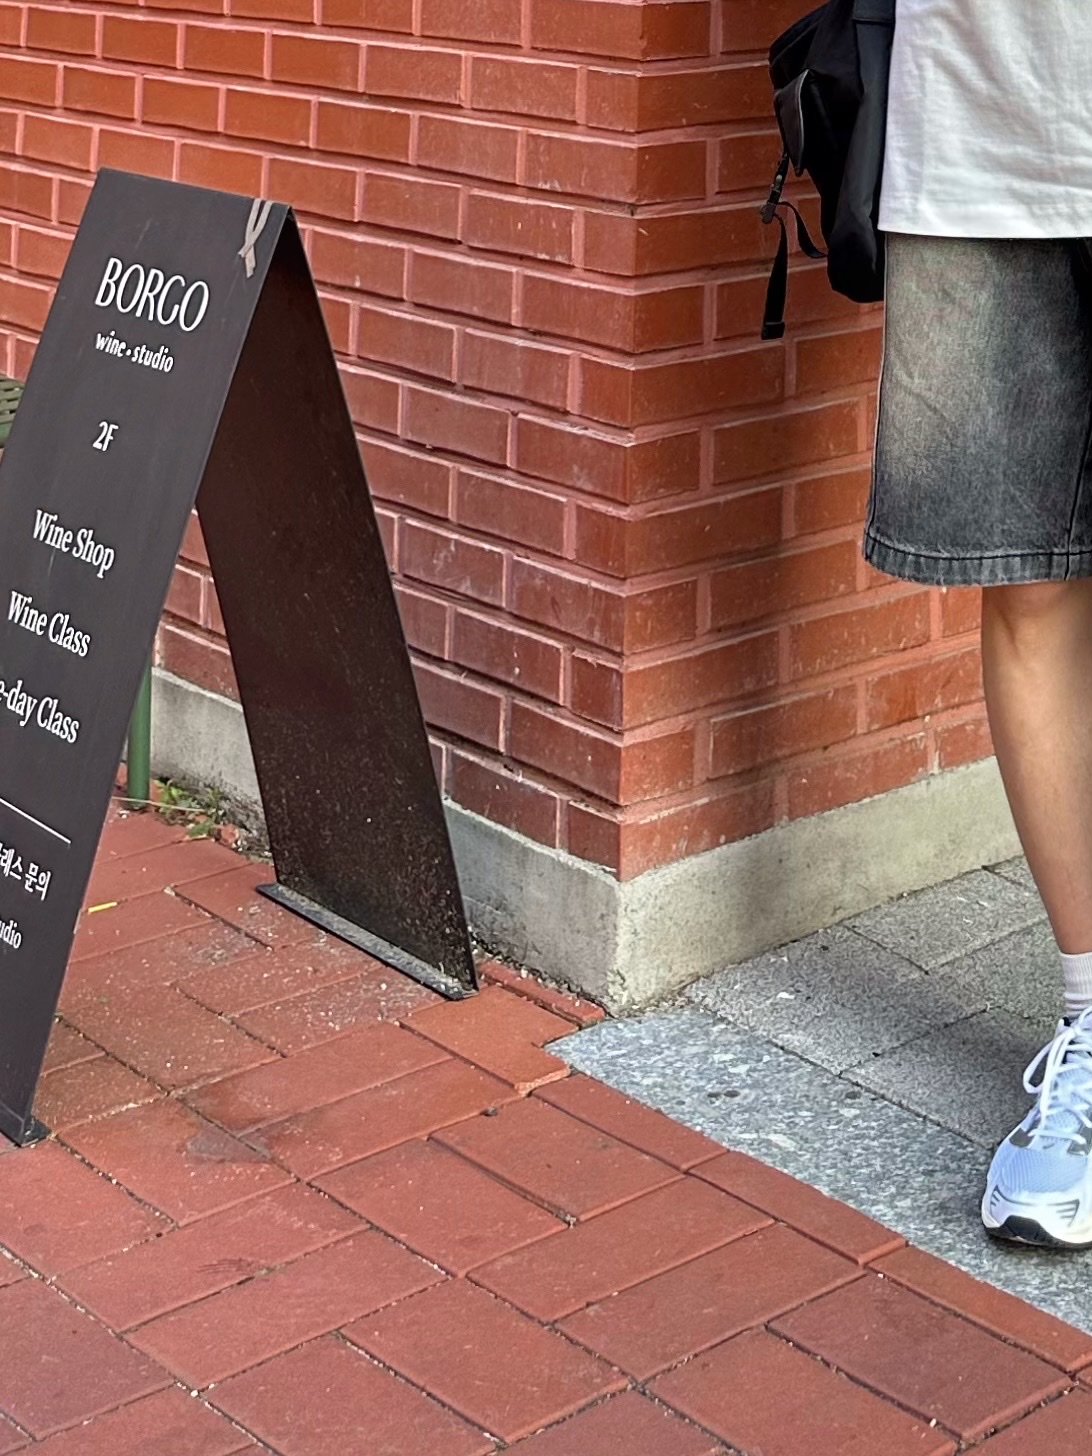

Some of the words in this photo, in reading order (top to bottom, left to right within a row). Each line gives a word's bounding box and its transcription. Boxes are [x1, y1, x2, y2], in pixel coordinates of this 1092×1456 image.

[94, 257, 210, 332] BORGO
[92, 421, 119, 452] 2F
[33, 509, 73, 553] Wine
[72, 528, 115, 579] Shop
[8, 590, 48, 636] Wine
[48, 612, 91, 657] Class
[36, 696, 80, 744] Class
[24, 862, 52, 902] 문의
